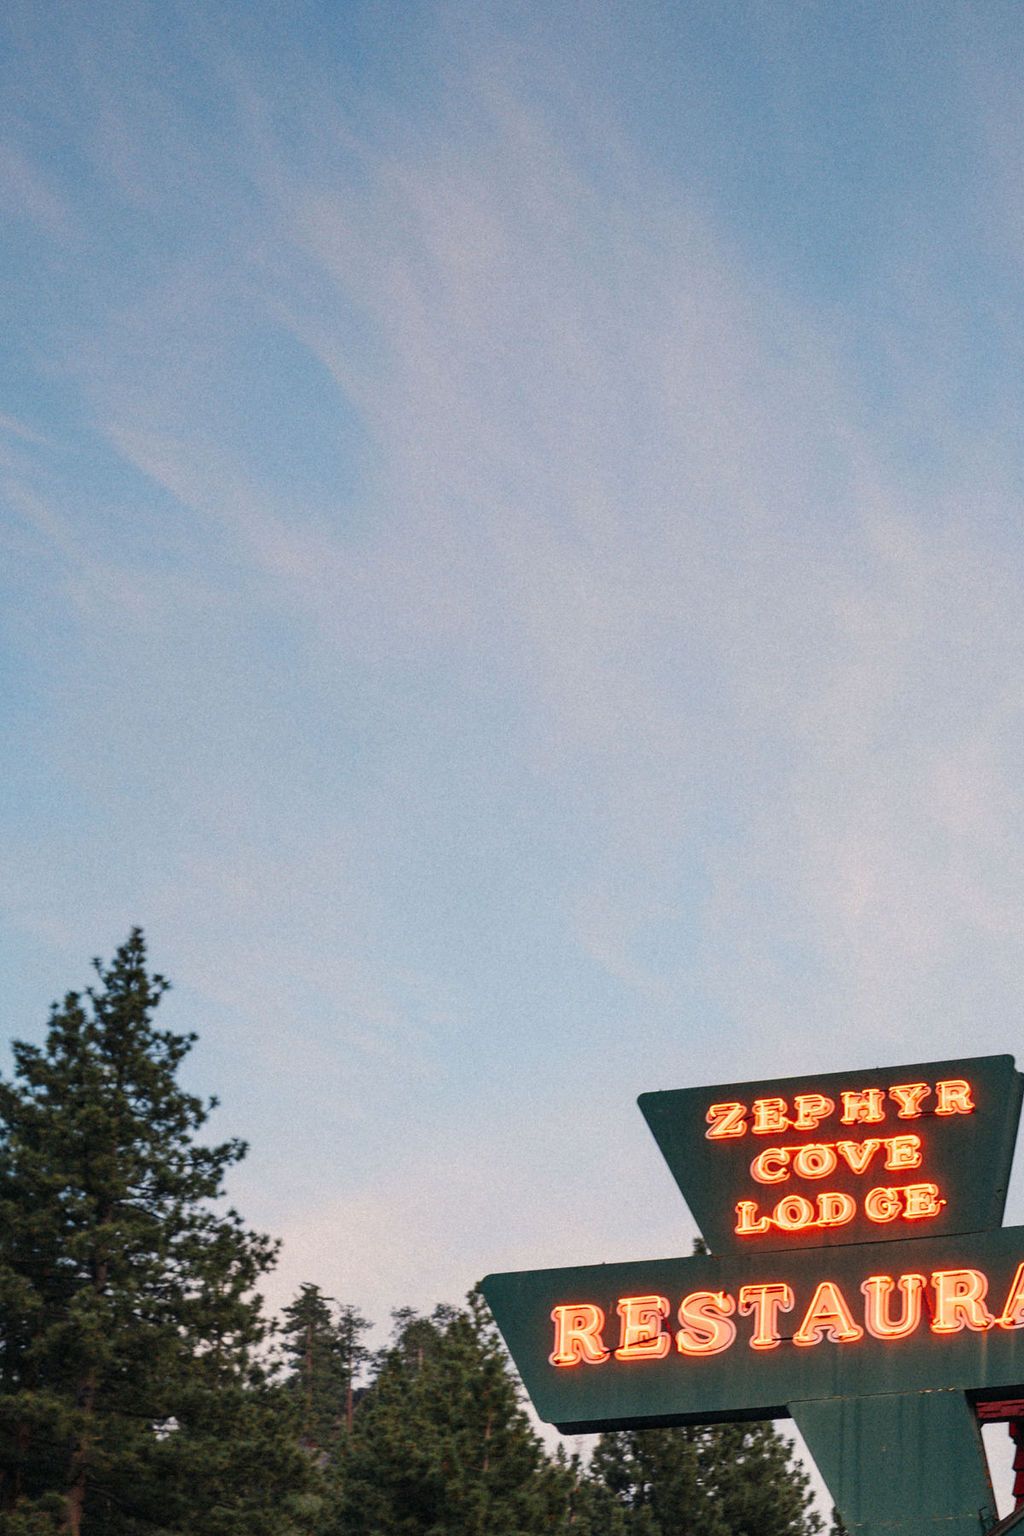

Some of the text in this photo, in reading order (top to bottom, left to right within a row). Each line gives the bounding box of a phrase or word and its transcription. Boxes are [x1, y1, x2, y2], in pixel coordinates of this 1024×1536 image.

[705, 1080, 975, 1139] ZEPHYR
[750, 1133, 923, 1184] COVE
[736, 1184, 943, 1234] LODGE
